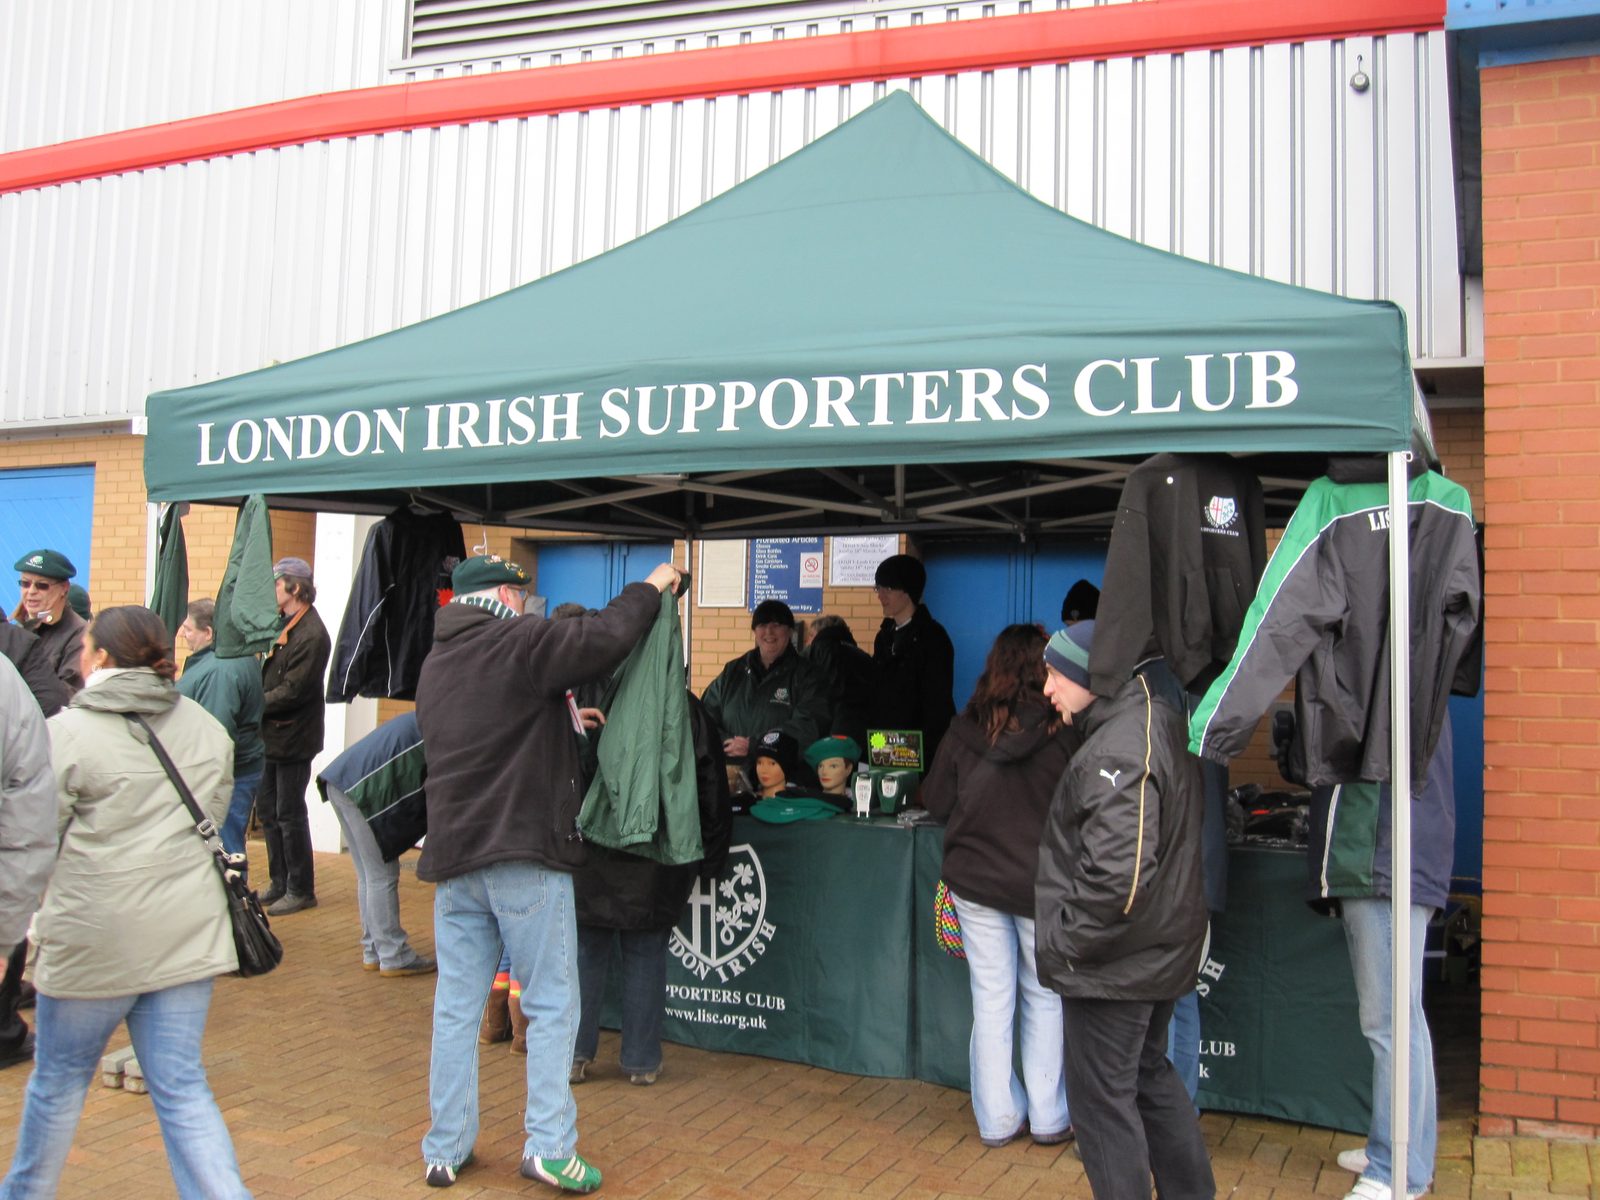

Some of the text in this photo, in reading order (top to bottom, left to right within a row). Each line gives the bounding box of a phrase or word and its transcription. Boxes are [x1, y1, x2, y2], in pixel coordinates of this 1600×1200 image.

[197, 349, 1299, 466] LONDON IRISH SUPPORTERS CLUB
[1367, 509, 1391, 532] LIS
[715, 919, 777, 984] IRISH
[665, 984, 786, 1011] PORTERS CLUB
[664, 1006, 768, 1030] www.lisc.org.uk
[1198, 1039, 1236, 1057] LUB
